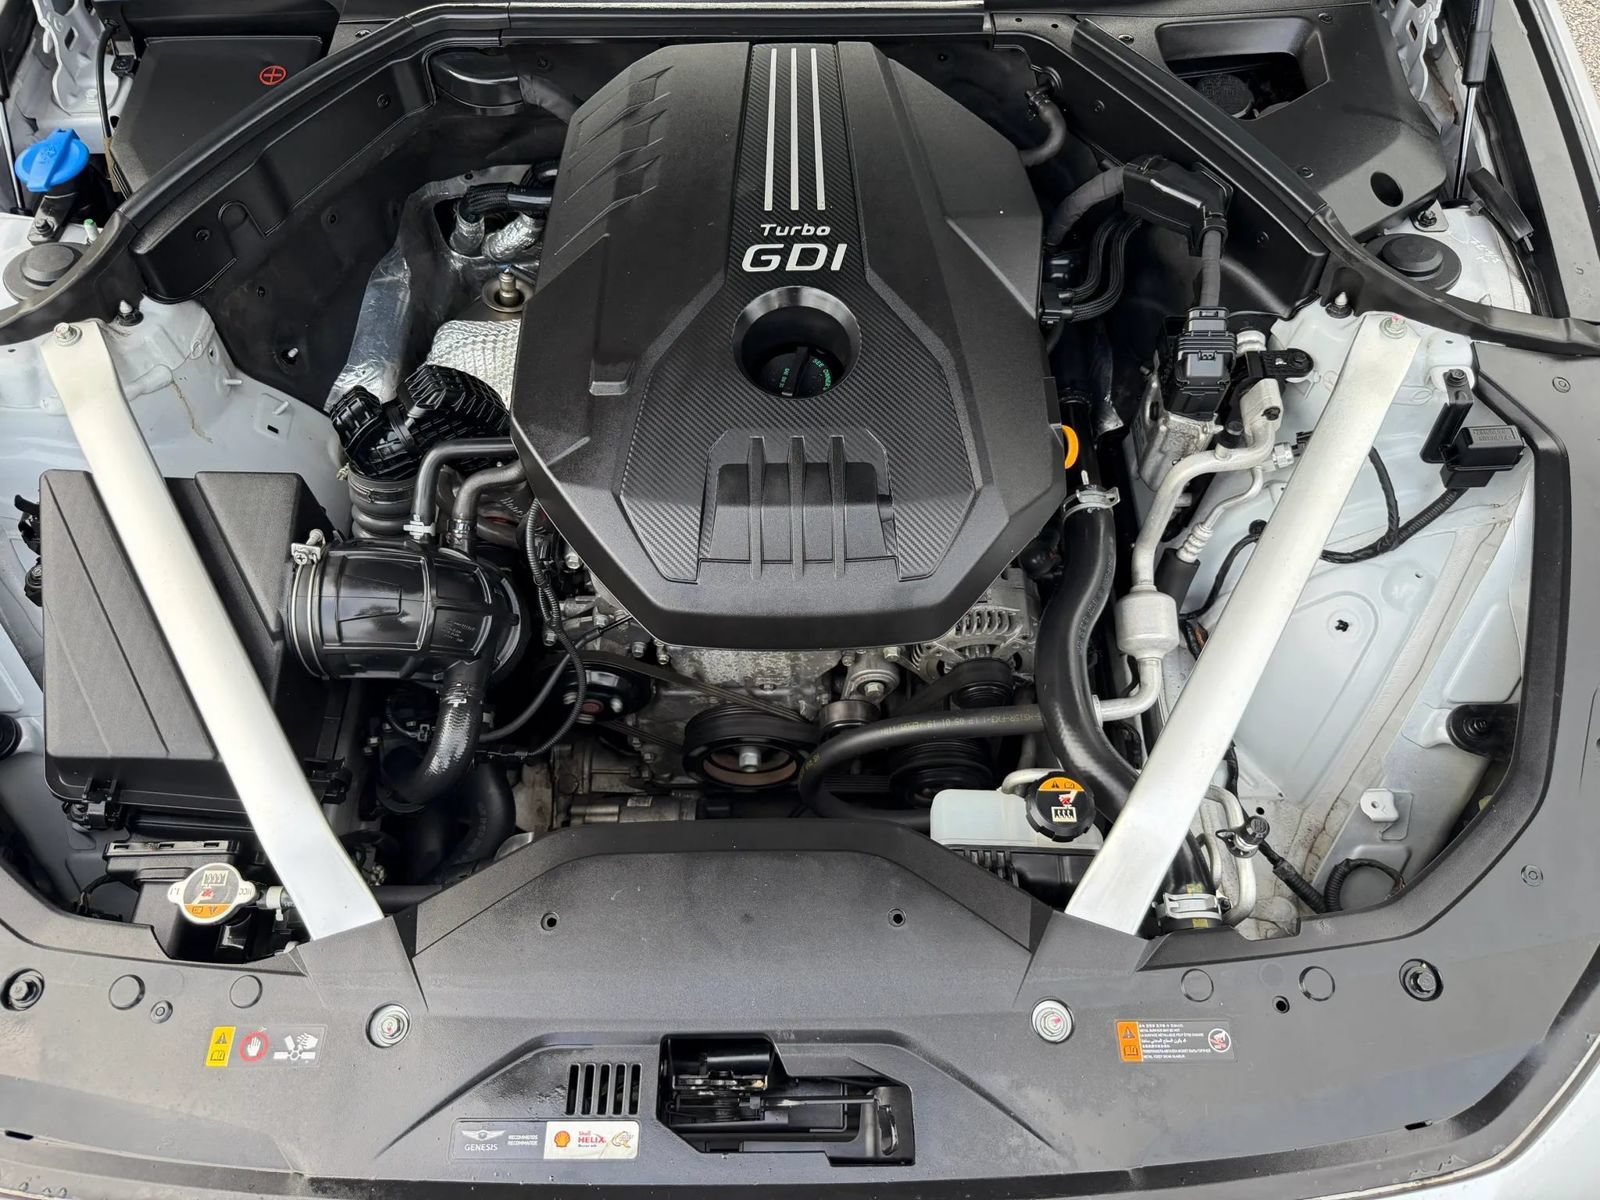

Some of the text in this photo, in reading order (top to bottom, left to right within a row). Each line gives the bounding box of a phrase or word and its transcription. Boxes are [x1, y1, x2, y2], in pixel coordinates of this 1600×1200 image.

[760, 223, 831, 236] Turbo
[741, 243, 848, 272] GDI
[577, 1136, 605, 1144] HELIX
[464, 1143, 499, 1152] GENESIS
